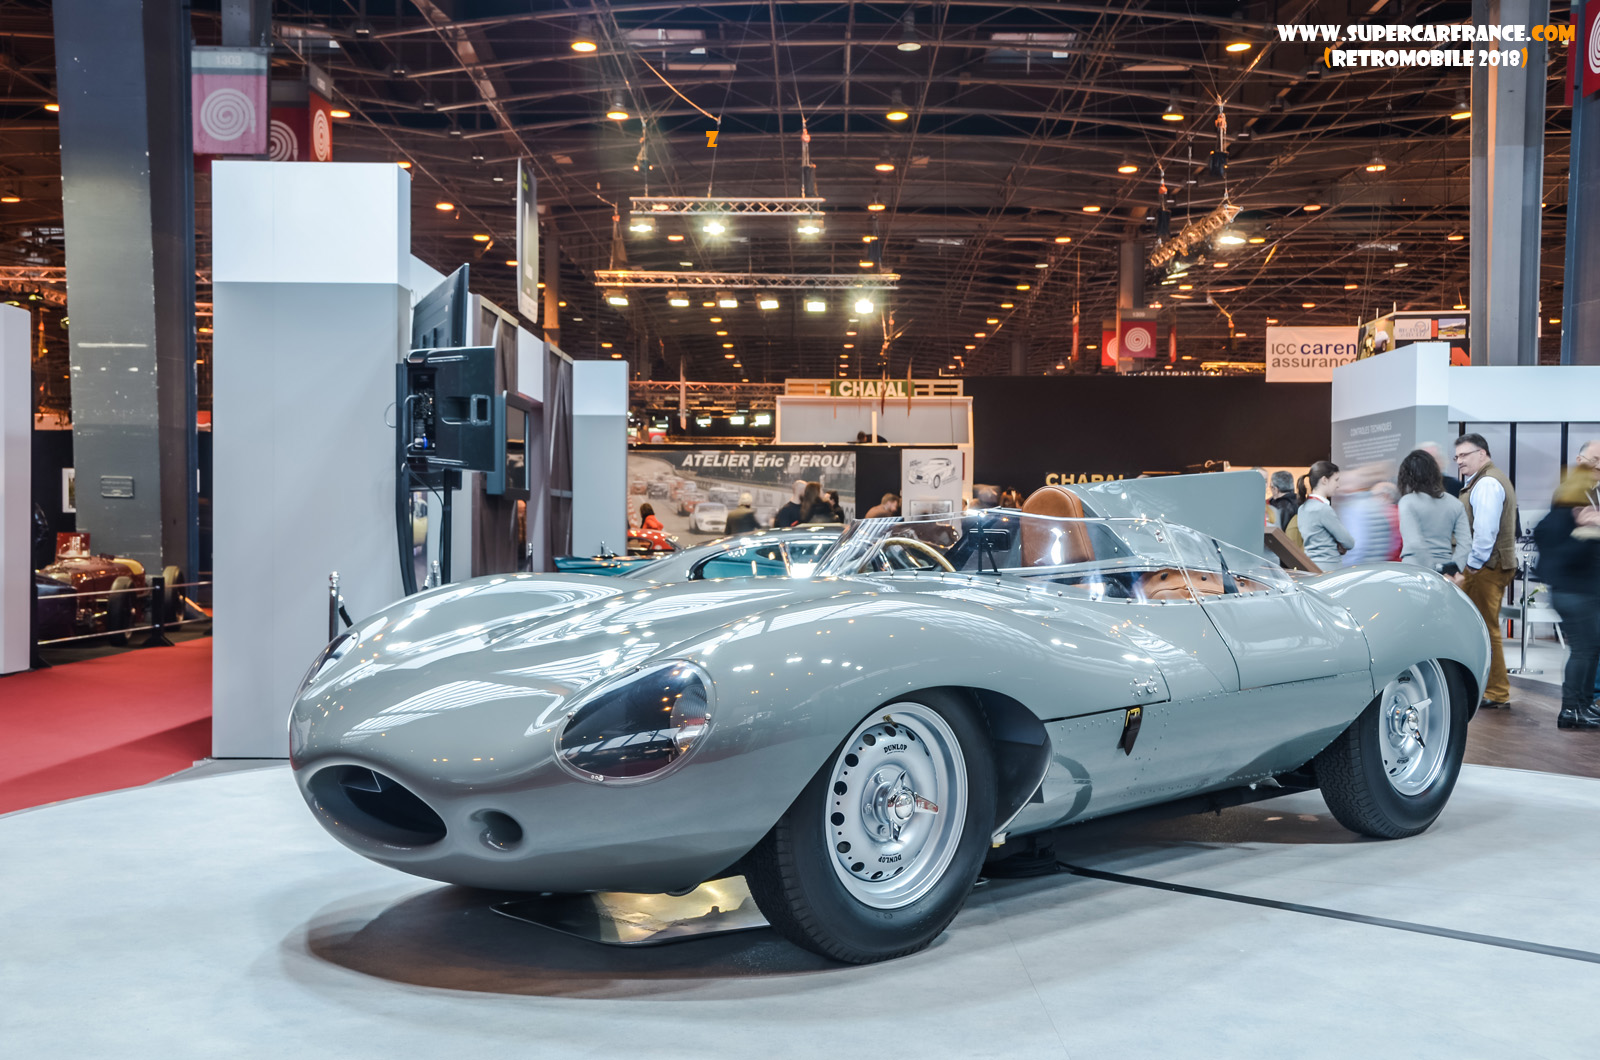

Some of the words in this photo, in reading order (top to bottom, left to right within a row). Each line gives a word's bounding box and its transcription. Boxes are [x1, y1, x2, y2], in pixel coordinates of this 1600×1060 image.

[1271, 343, 1297, 355] ICC
[838, 381, 906, 397] CHAPAL
[681, 453, 750, 468] ATELIER
[753, 453, 785, 468] Eric
[788, 453, 845, 468] PEROU
[883, 743, 907, 753] DUNLOP
[878, 854, 902, 863] DUNLOP
